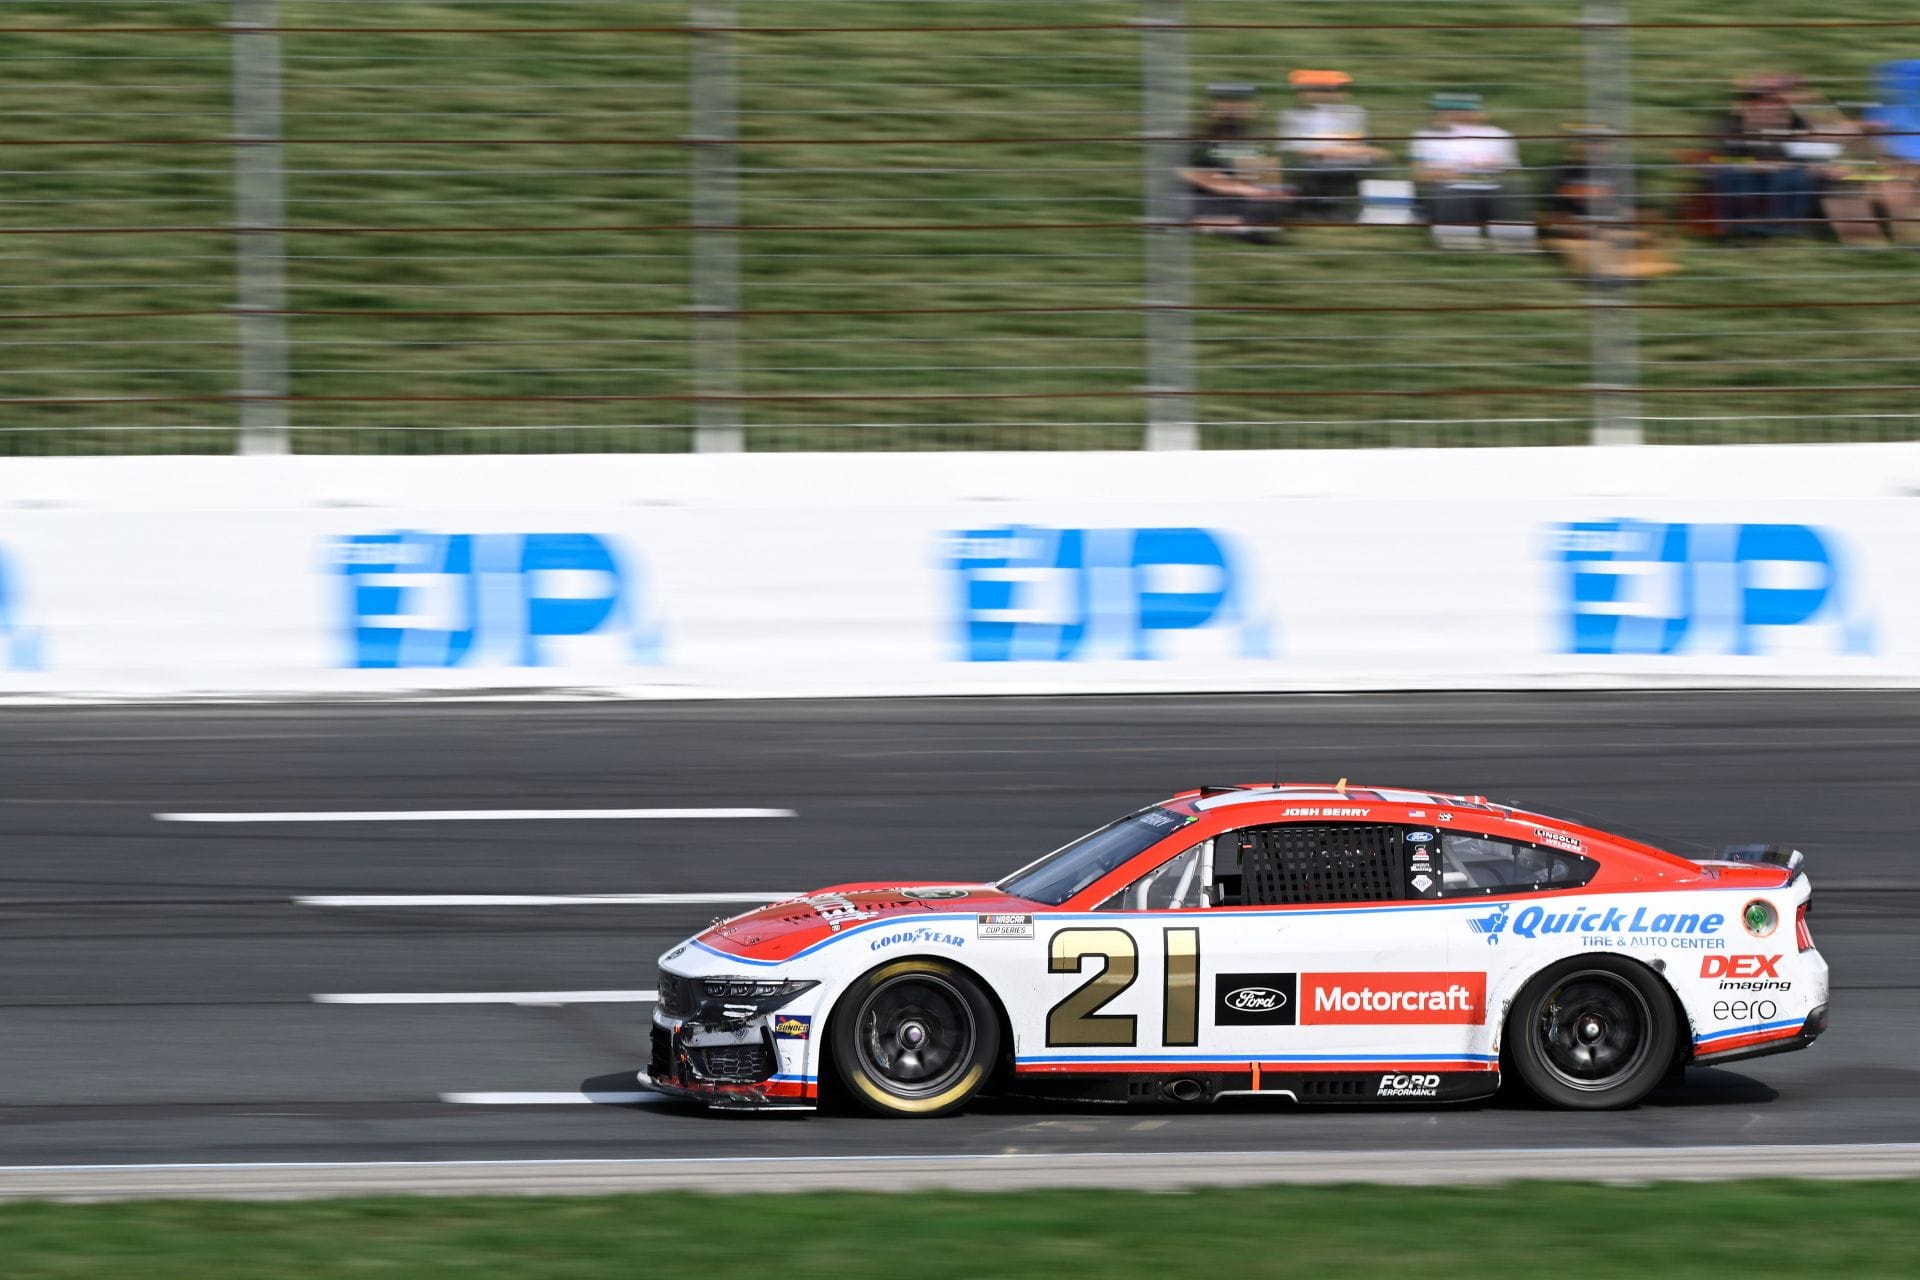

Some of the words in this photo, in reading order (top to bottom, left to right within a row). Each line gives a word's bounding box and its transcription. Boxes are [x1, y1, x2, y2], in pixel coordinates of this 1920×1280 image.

[1281, 807, 1319, 817] JOSH
[1322, 807, 1370, 817] BERRY
[1536, 830, 1578, 846] LINCOLN
[995, 915, 1025, 924] NASCAR
[985, 926, 1001, 934] CUP
[1001, 926, 1026, 934] SERIES
[1580, 936, 1613, 947] TIRE
[1617, 937, 1626, 947] &
[1630, 937, 1668, 948] AUTO
[1670, 936, 1725, 949] CENTER
[1700, 954, 1783, 979] DEX
[1046, 927, 1200, 1048] 21
[1718, 979, 1792, 992] imaging
[1235, 989, 1276, 1009] Ford
[1315, 984, 1470, 1012] Motorcraft
[1713, 1000, 1777, 1020] eero
[776, 1023, 810, 1032] SUNOCO
[1379, 1074, 1440, 1089] FORD
[1377, 1088, 1437, 1097] PERFORMANCE
